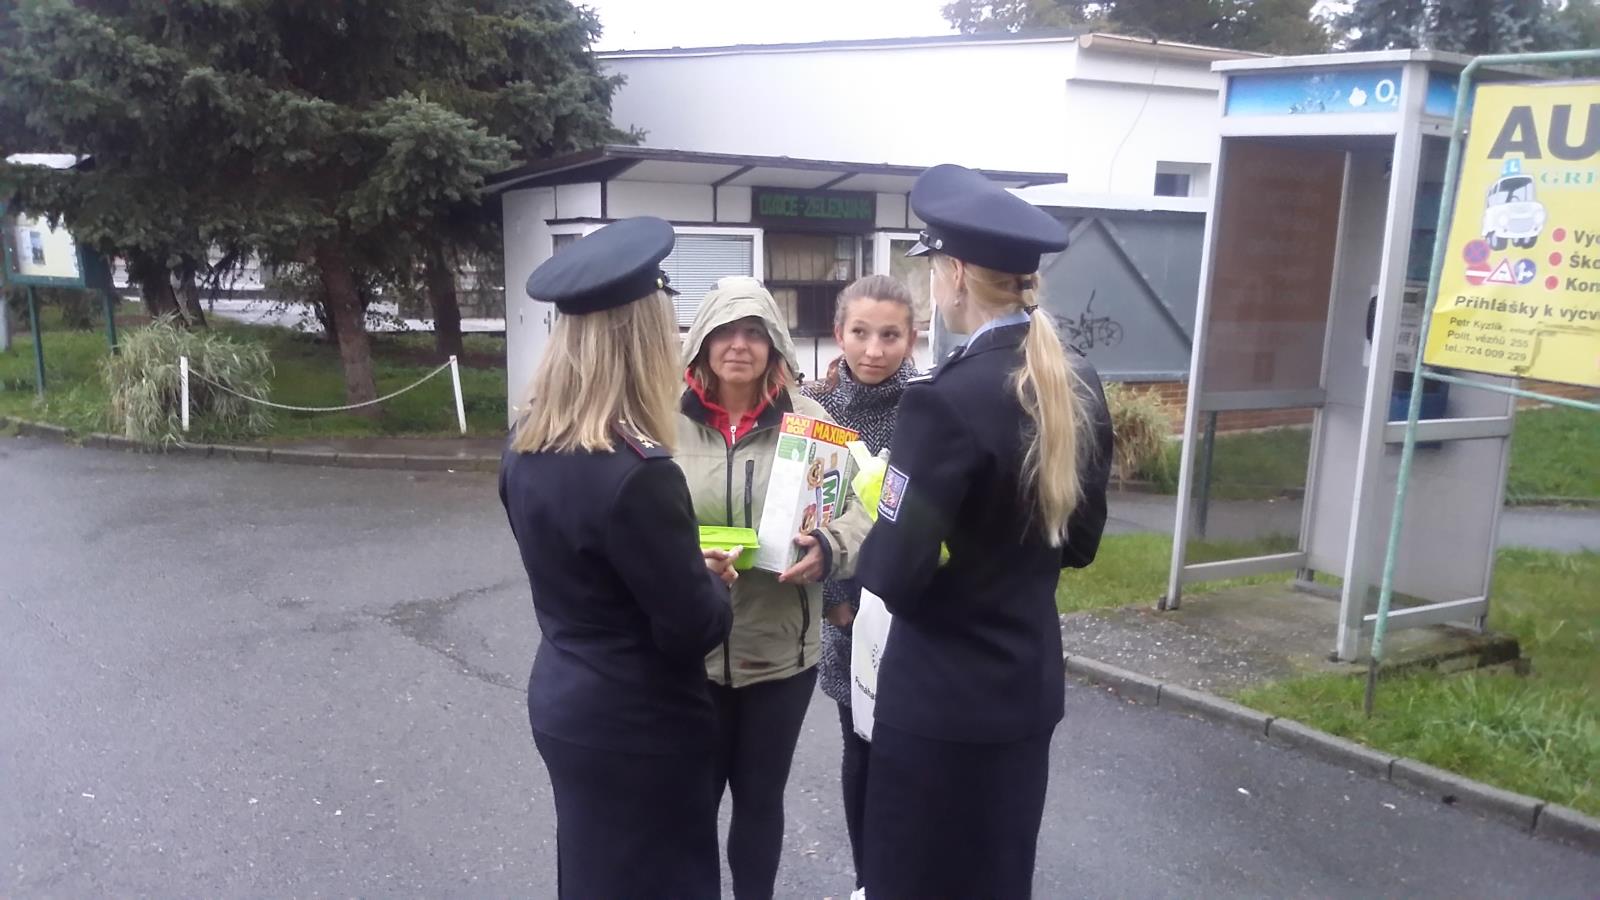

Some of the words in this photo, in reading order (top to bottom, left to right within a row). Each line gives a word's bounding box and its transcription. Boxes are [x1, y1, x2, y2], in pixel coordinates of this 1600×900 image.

[1487, 103, 1600, 161] AU
[1454, 295, 1538, 318] Přihlášky
[1543, 304, 1552, 317] k
[786, 415, 811, 427] MAXI
[785, 425, 806, 436] BOX
